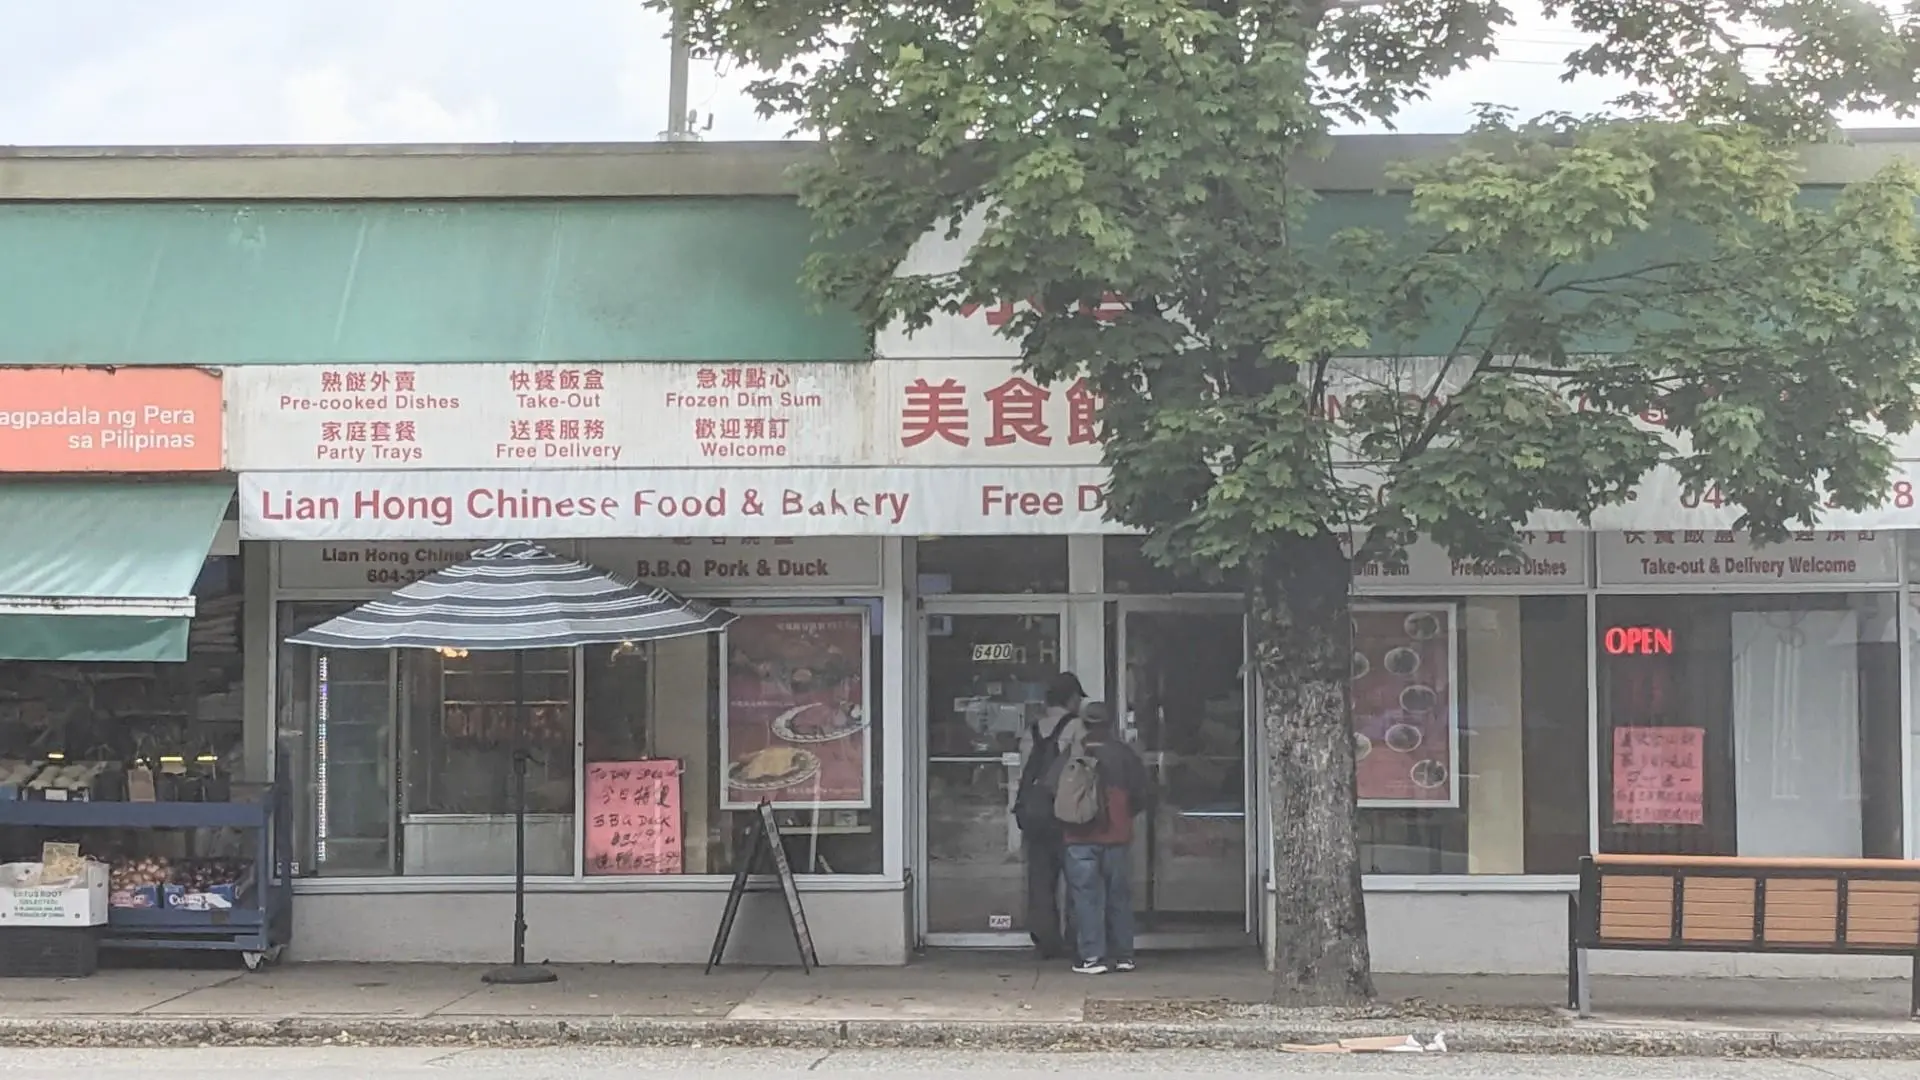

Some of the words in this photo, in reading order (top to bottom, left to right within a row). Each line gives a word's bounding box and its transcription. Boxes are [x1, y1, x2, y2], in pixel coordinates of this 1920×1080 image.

[510, 369, 604, 391] 快餐飯盒
[697, 367, 791, 389] 急凍點心
[281, 395, 388, 410] Pre-cooked
[395, 394, 460, 410] Dishes
[516, 393, 600, 408] Take-Out
[666, 392, 730, 408] Frozen
[737, 391, 773, 407] Dim
[780, 391, 822, 407] Sum
[107, 410, 136, 428] ng
[144, 405, 195, 425] Pera
[322, 421, 415, 442] 家庭套餐
[510, 419, 604, 441] 送餐服務
[695, 418, 789, 439] 歡迎預訂
[68, 434, 93, 449] sa
[101, 430, 195, 452] Pilipinas
[496, 443, 537, 458] Free
[544, 442, 622, 460] Delivery
[701, 442, 786, 457] Welcome
[317, 445, 365, 462] Party
[372, 444, 423, 462] Trays
[262, 490, 340, 520] Lian
[354, 489, 452, 525] Hong
[467, 488, 620, 520] Chinese
[634, 487, 726, 517] Food
[741, 488, 764, 516] &
[782, 489, 910, 524] Bakery
[982, 485, 1064, 516] Free
[322, 547, 360, 562] Lian
[365, 548, 410, 566] Hong
[1640, 557, 1706, 575] Take-out
[1708, 557, 1721, 574] &
[1724, 555, 1785, 578] Delivery
[1788, 555, 1857, 574] Welcome
[704, 559, 750, 577] Pork
[756, 558, 772, 577] &
[777, 558, 829, 577] Duck
[1605, 627, 1673, 654] OPEN
[974, 645, 1011, 658] 6400
